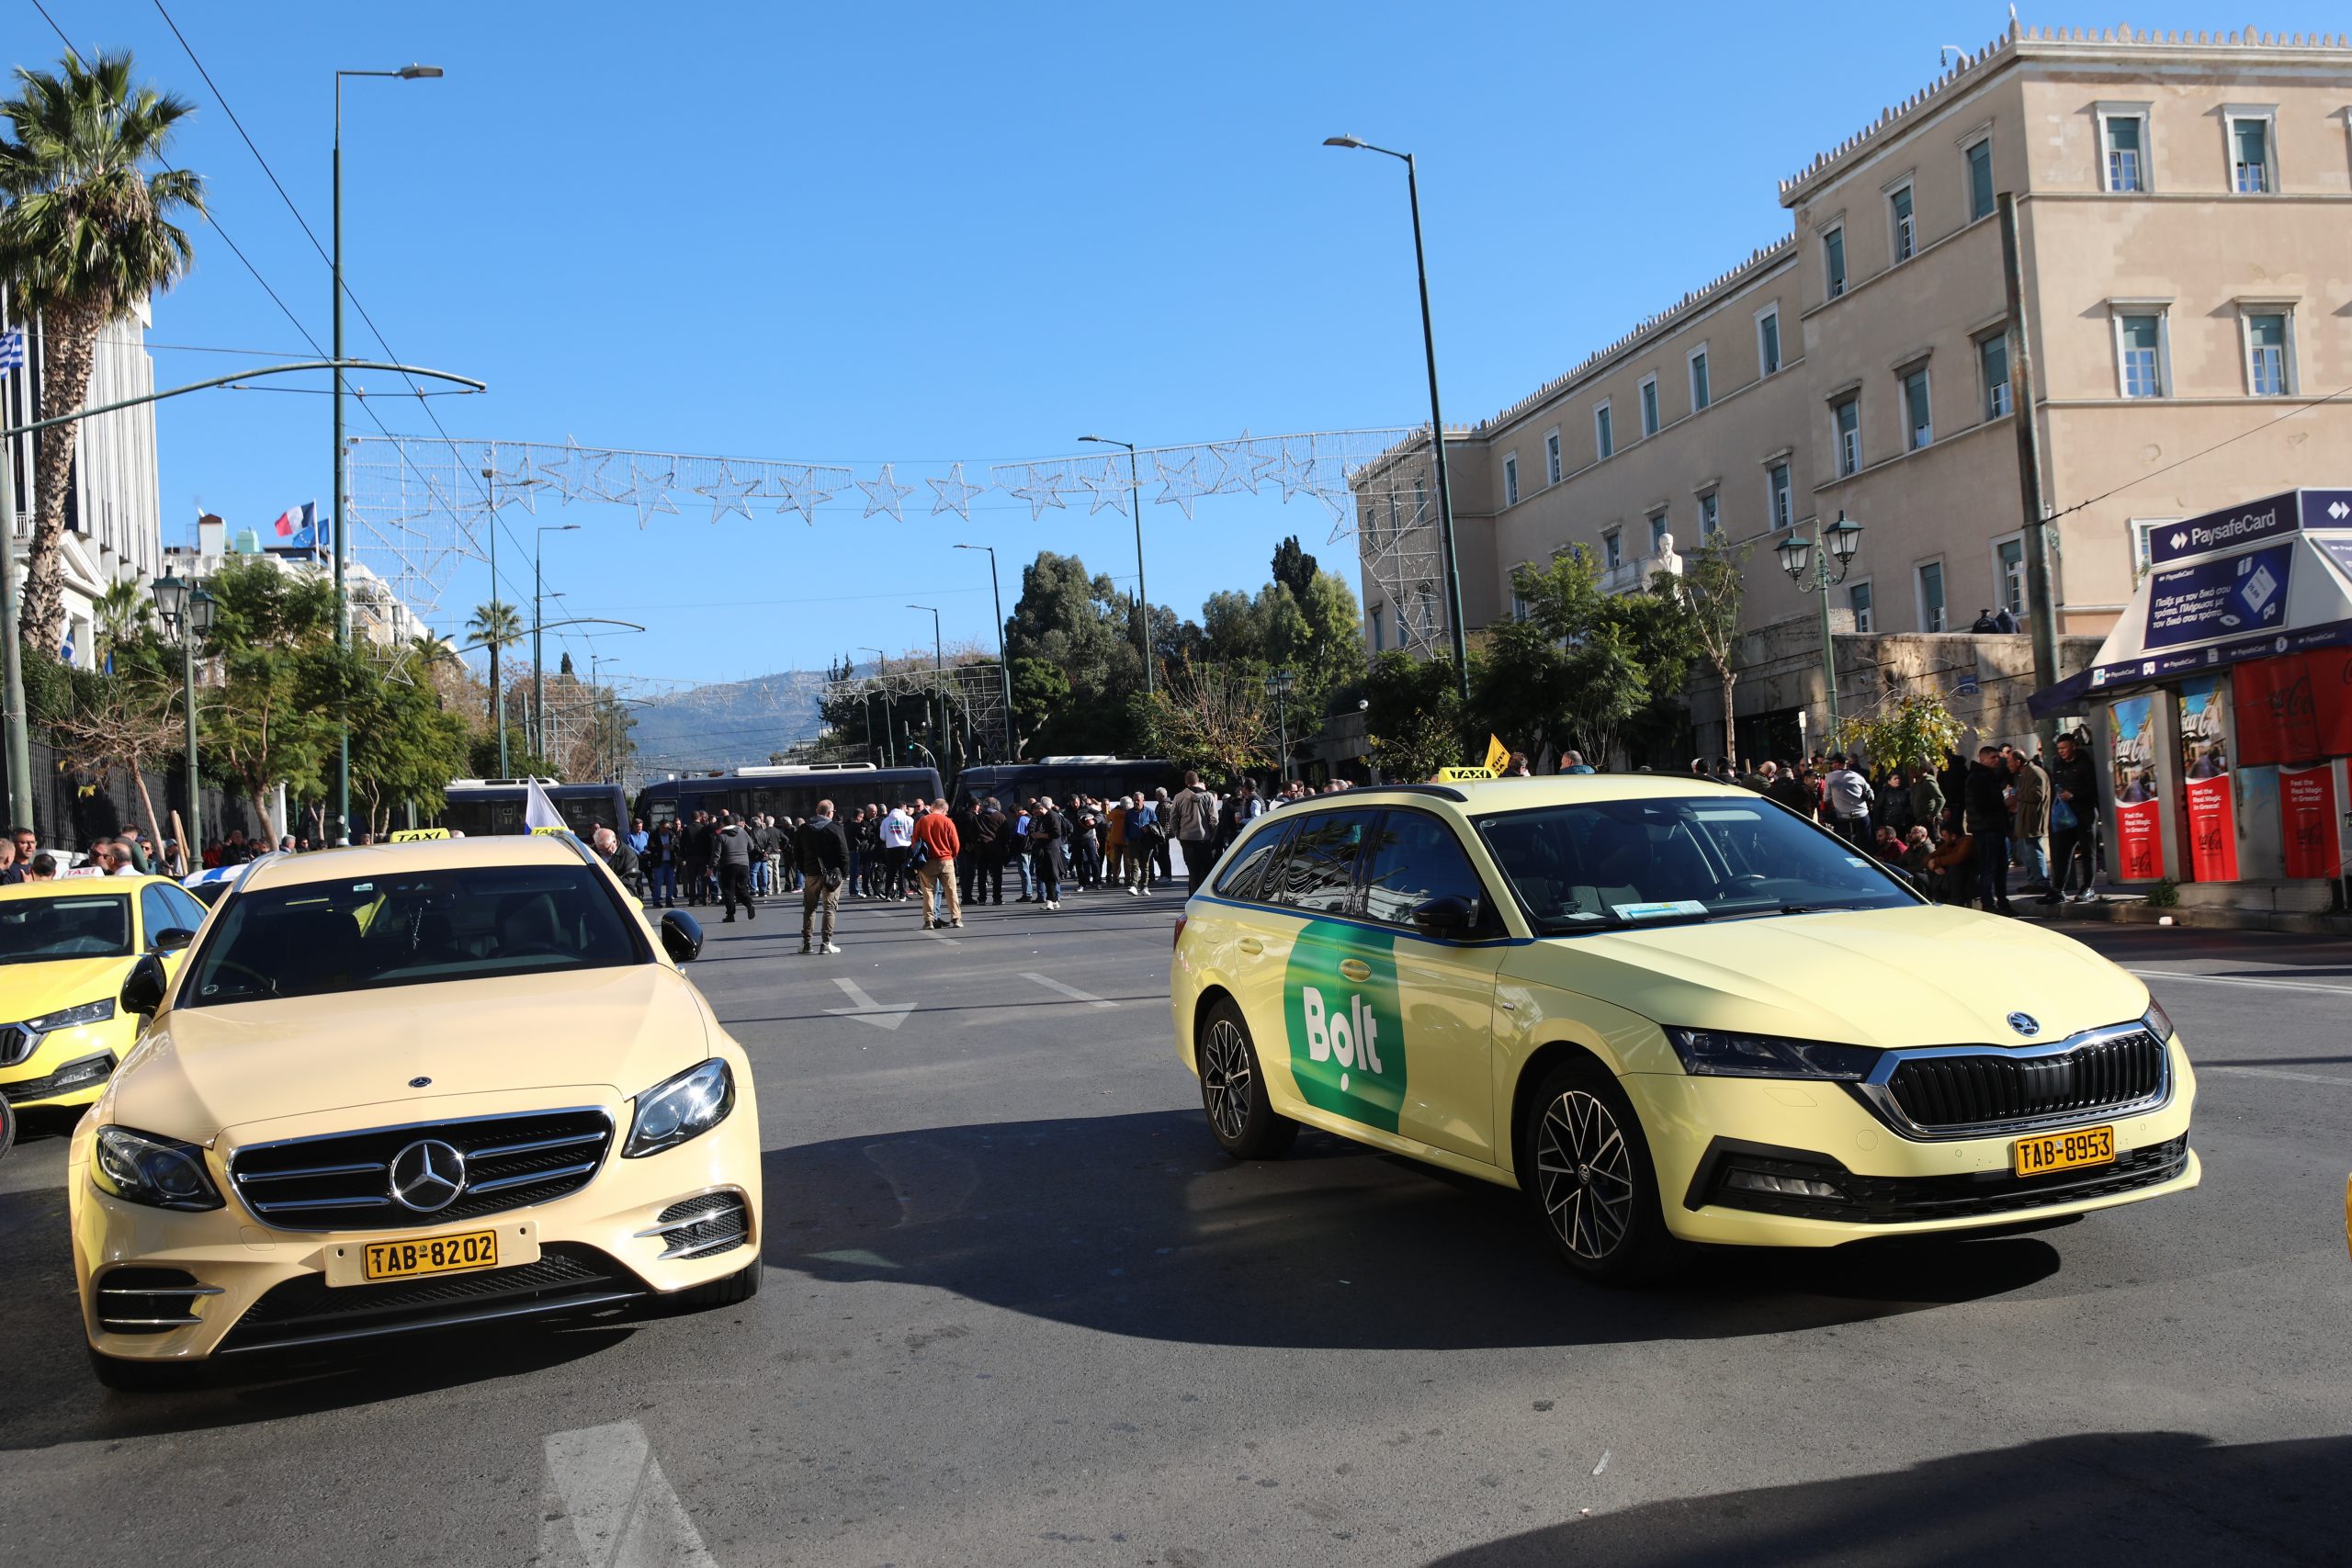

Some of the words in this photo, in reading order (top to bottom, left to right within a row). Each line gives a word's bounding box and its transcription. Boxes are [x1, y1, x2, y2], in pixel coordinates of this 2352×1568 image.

[2191, 507, 2277, 547] PaysafeCard
[398, 831, 441, 841] TAXI
[1303, 986, 1383, 1091] Bolt
[2019, 1132, 2110, 1169] TAB-8953
[370, 1235, 492, 1274] TAB-8202
